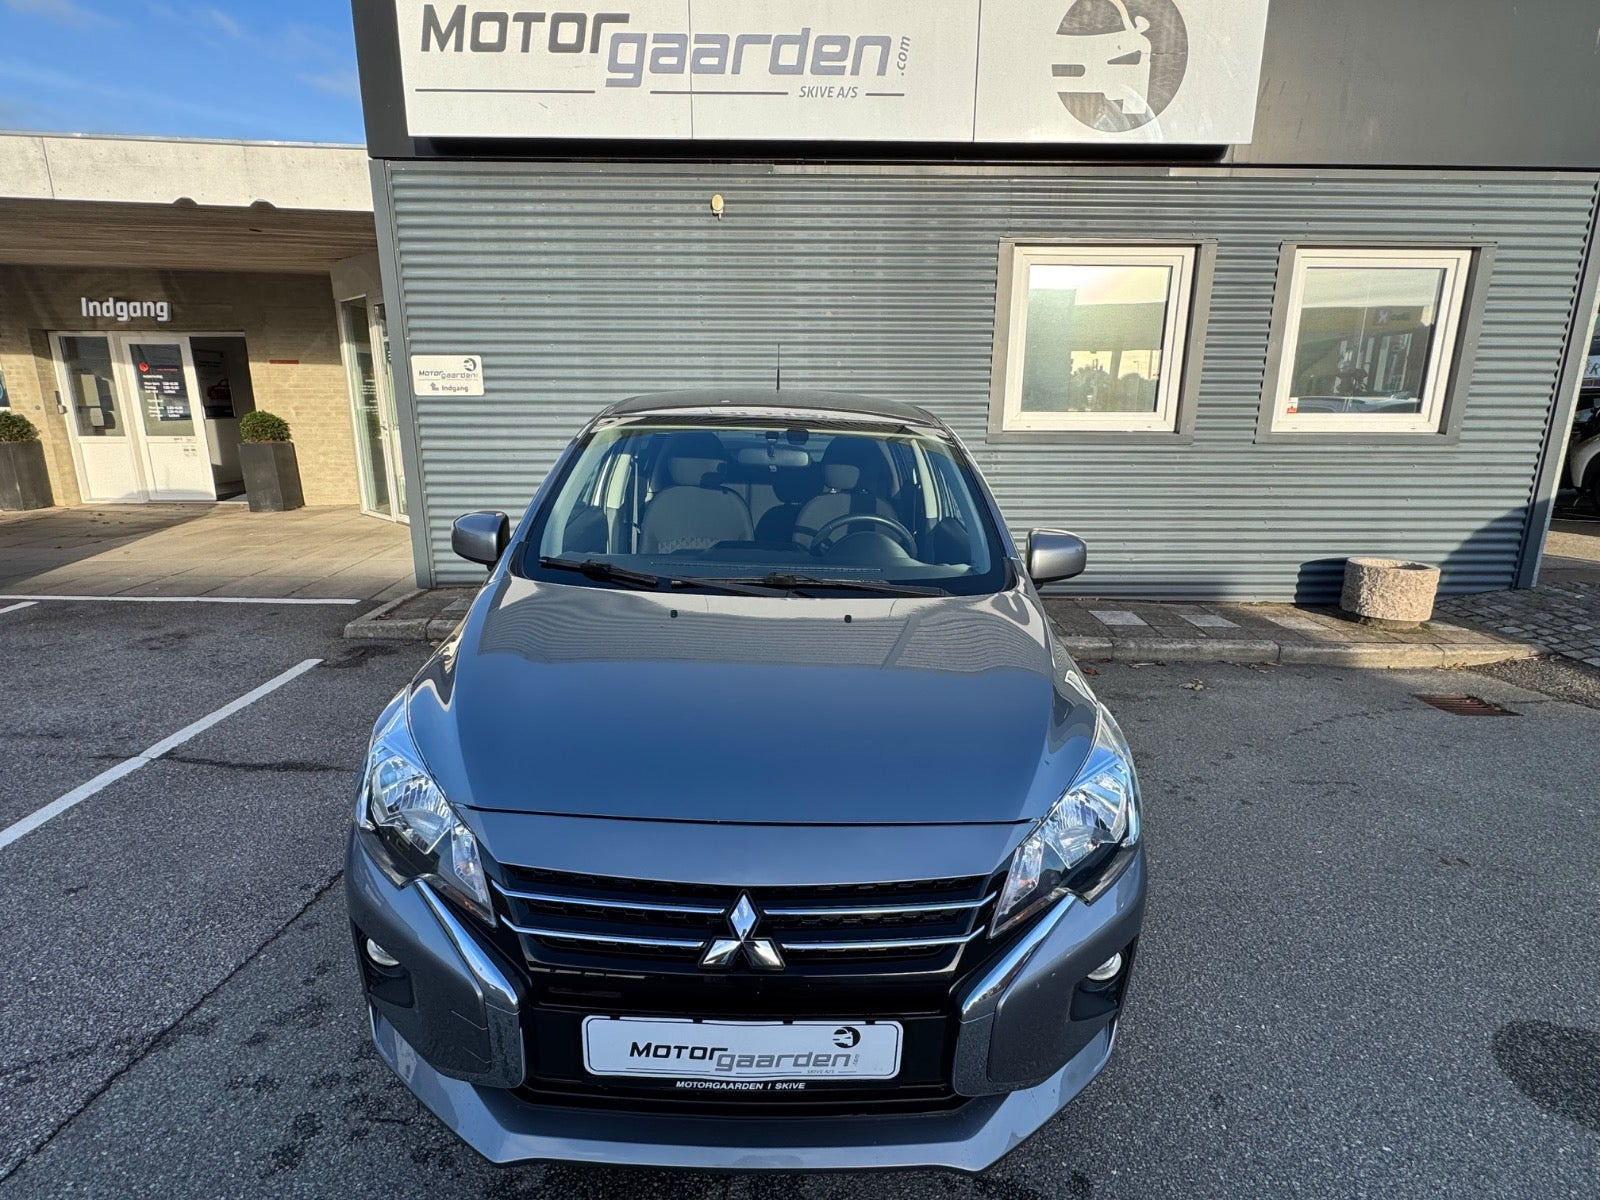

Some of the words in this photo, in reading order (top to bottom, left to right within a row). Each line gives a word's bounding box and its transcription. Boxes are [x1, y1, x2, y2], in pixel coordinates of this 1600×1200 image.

[896, 36, 911, 76] .com
[799, 85, 835, 98] SKIVE
[836, 86, 859, 98] A/S
[81, 297, 169, 322] Indgang
[441, 384, 469, 392] Indgang
[675, 1080, 764, 1090] MOTORGAARDEN
[774, 1082, 806, 1090] SKIVE
